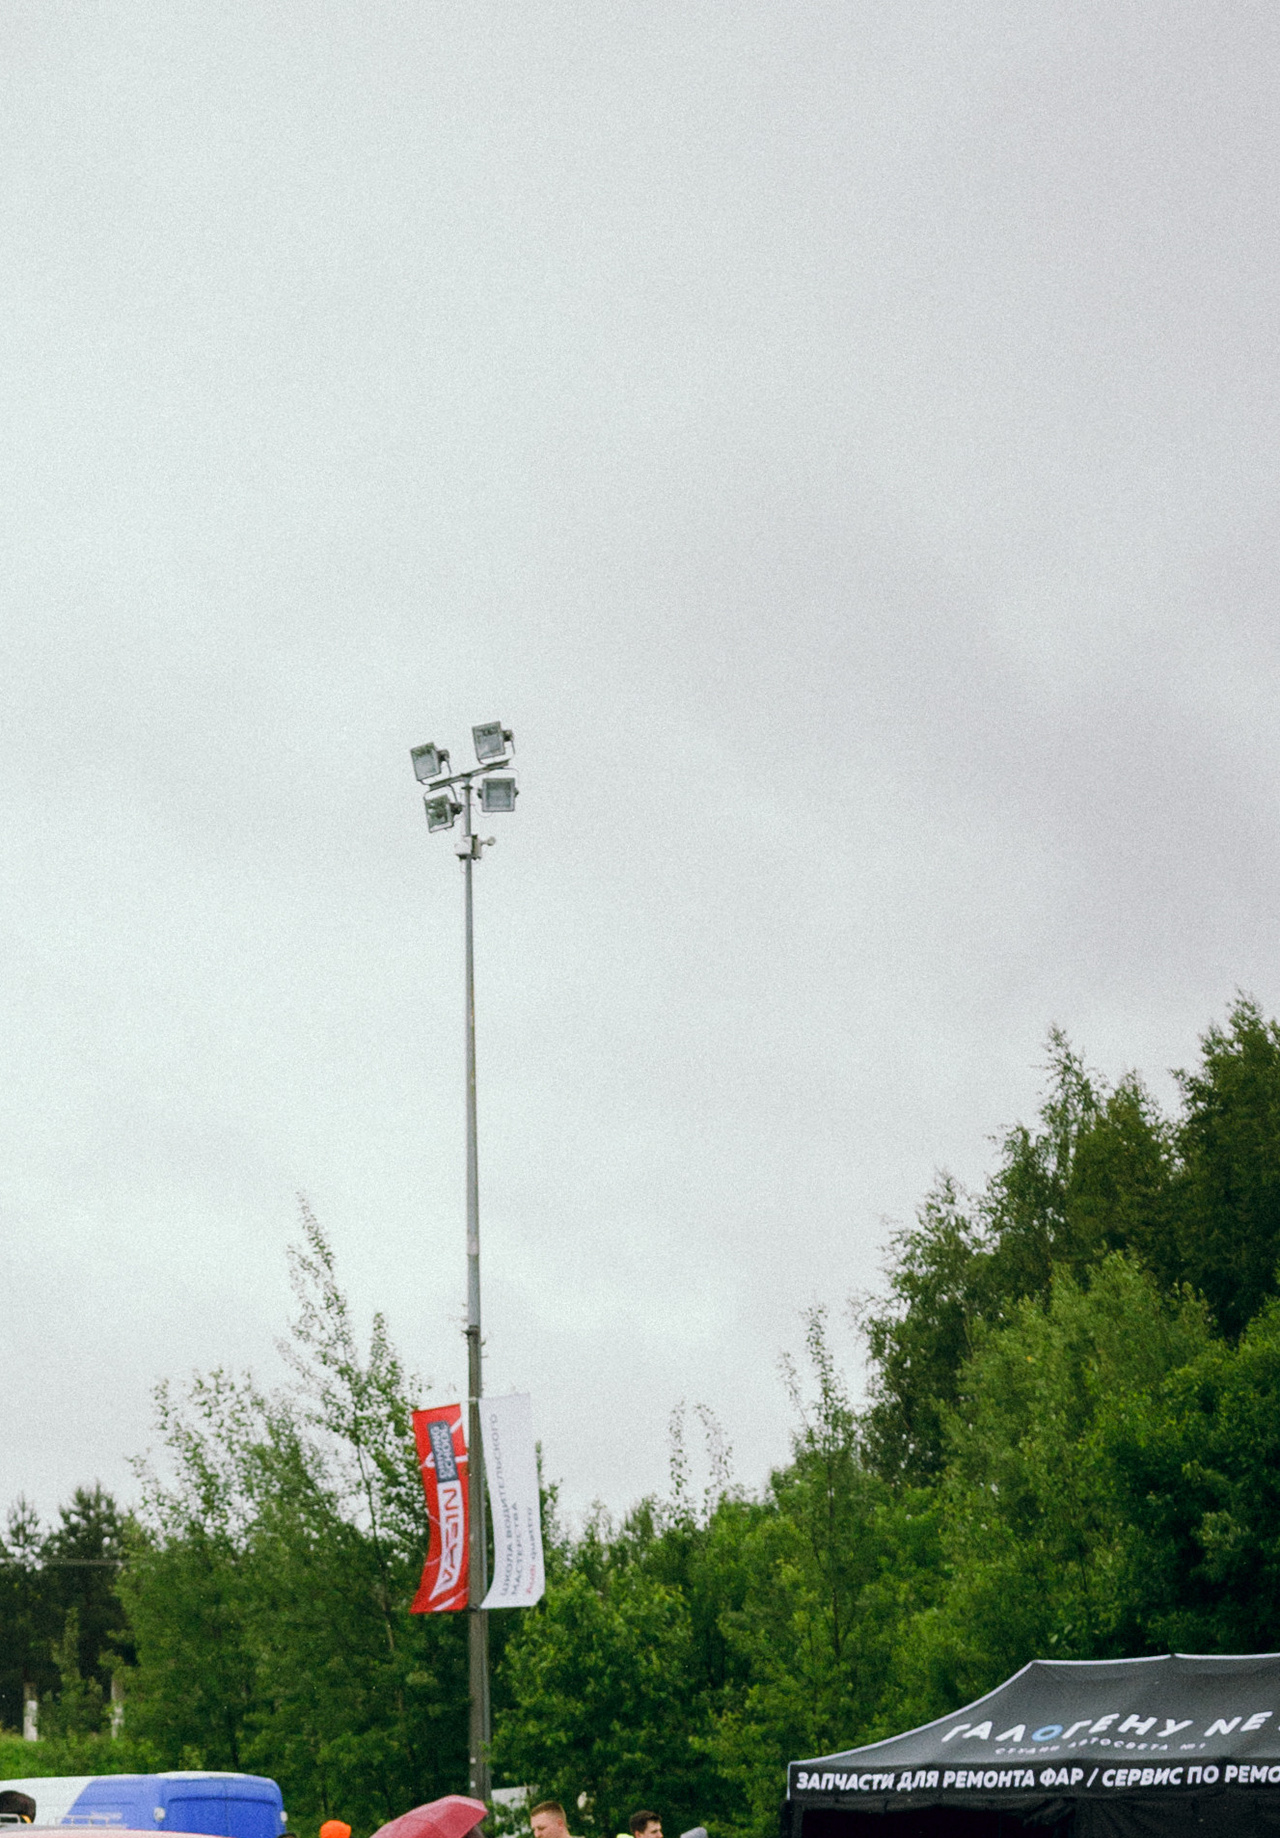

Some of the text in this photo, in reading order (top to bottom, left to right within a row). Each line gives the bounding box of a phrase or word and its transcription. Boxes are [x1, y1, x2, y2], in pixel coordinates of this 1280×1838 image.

[432, 1425, 446, 1478] DRIVING
[439, 1424, 456, 1478] SCHOOL
[489, 1413, 514, 1596] ШКОЛА ВОДИТЕЛЬСКОГО
[941, 1711, 1280, 1743] ГАЛОГЕНУ NE
[796, 1771, 895, 1791] ЗАПЧАСТИ
[896, 1770, 940, 1791] ДЛЯ
[942, 1769, 1035, 1789] РЕМОНТА
[1039, 1767, 1084, 1787] ФАР
[1101, 1766, 1184, 1787] СЕРВИС
[1186, 1765, 1220, 1785] ПО
